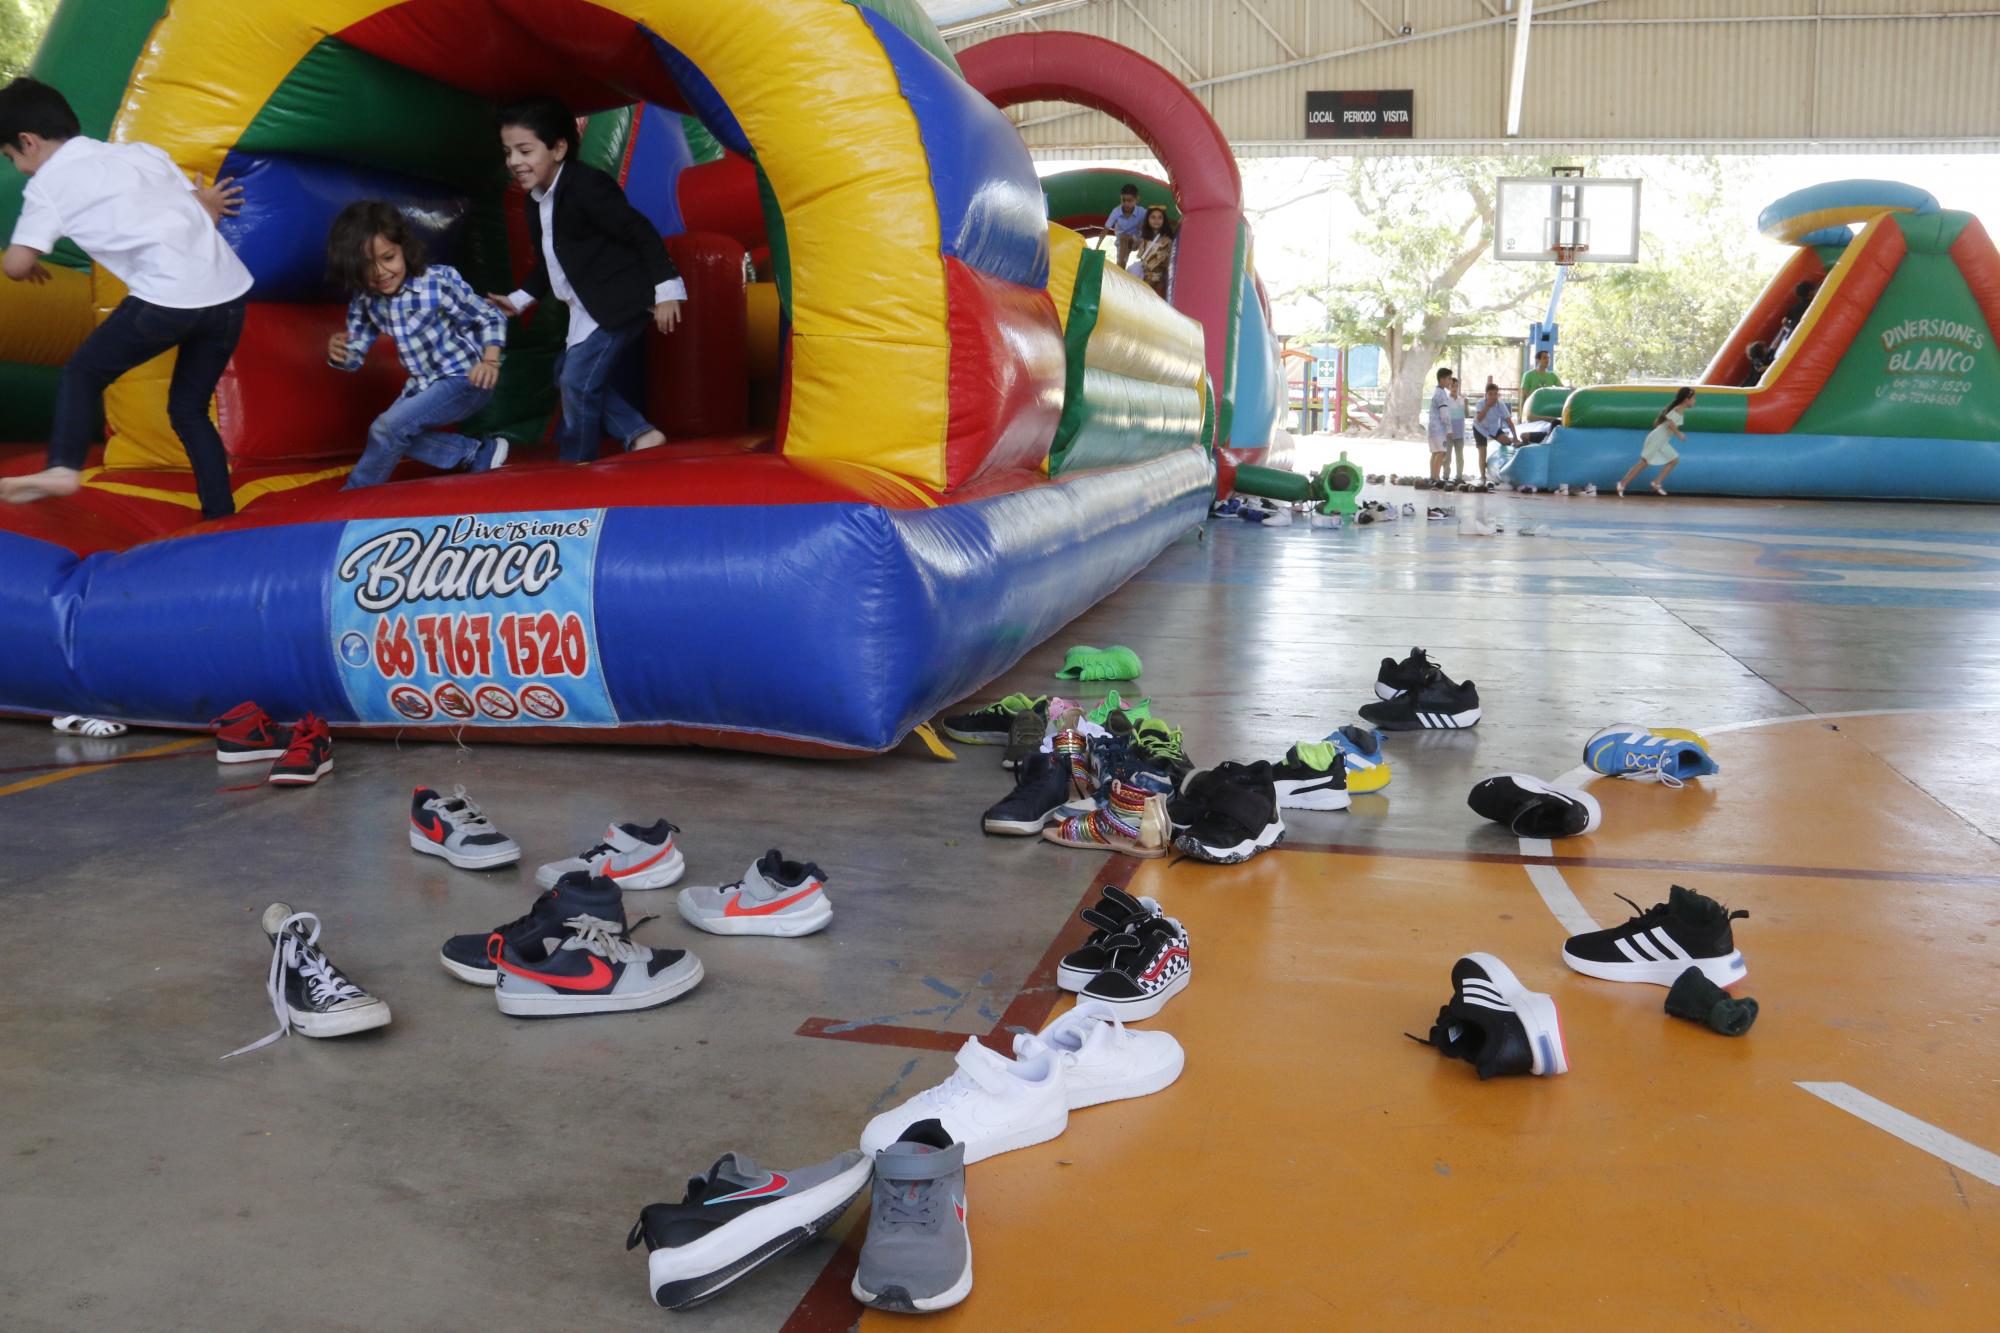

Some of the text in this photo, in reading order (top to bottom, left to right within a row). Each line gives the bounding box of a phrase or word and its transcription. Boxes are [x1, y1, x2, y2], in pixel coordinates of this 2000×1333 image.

[1309, 110, 1409, 123] LOCAL PERIODO VISITA
[1881, 319, 1985, 350] DIVERSIONES
[1888, 347, 1976, 373] BLANCO
[451, 515, 593, 544] Diversiones
[339, 525, 562, 613] Blanco
[373, 610, 588, 679] 66 7167 1520
